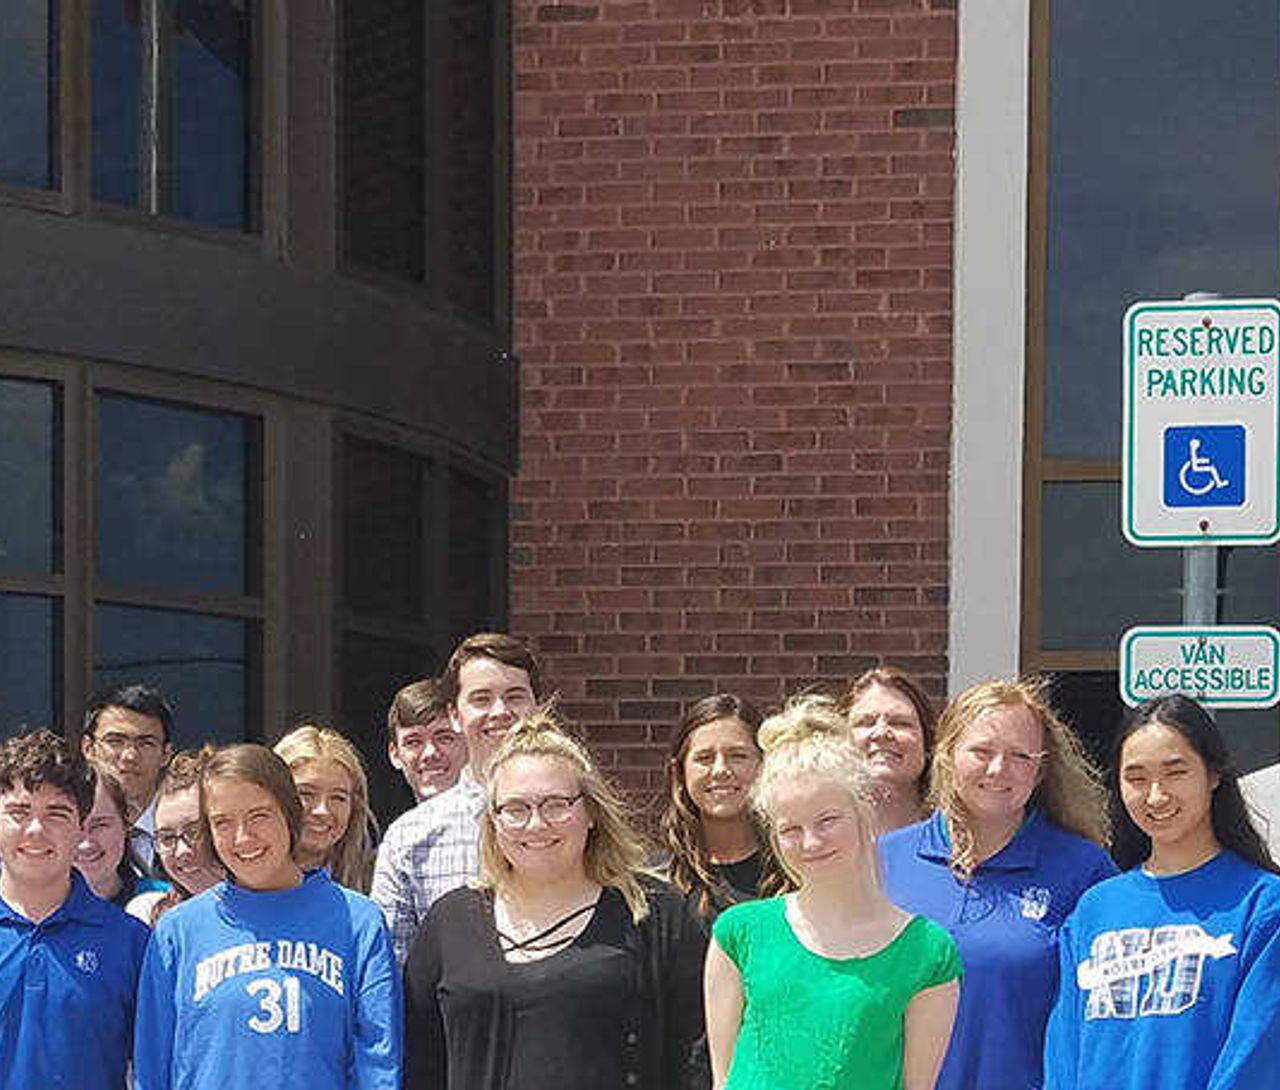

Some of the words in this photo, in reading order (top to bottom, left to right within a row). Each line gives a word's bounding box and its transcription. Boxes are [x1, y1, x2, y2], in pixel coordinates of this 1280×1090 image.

[1138, 326, 1275, 357] RESERVED
[1146, 366, 1266, 398] PARKING
[1180, 643, 1225, 665] VAN
[1133, 667, 1271, 697] ACCESSIBLE
[193, 942, 271, 1003] NOTRE
[277, 940, 344, 996] DAME
[246, 976, 300, 1034] 31
